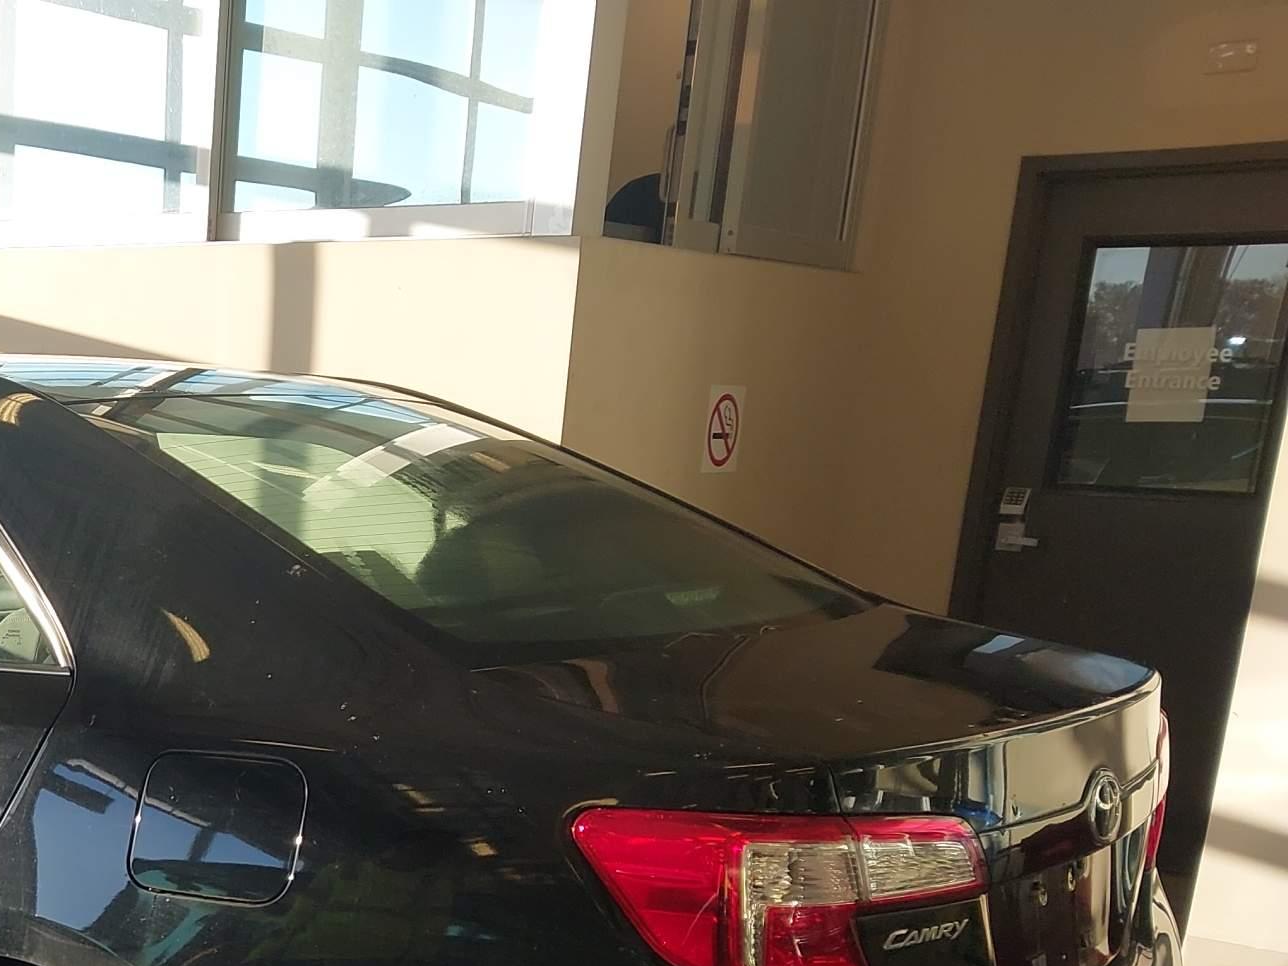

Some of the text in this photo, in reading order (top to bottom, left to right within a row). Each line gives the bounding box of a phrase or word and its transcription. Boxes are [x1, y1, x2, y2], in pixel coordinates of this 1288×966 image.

[1123, 342, 1232, 369] Employee
[1125, 371, 1221, 390] Entrance
[883, 919, 969, 950] CAMRY
